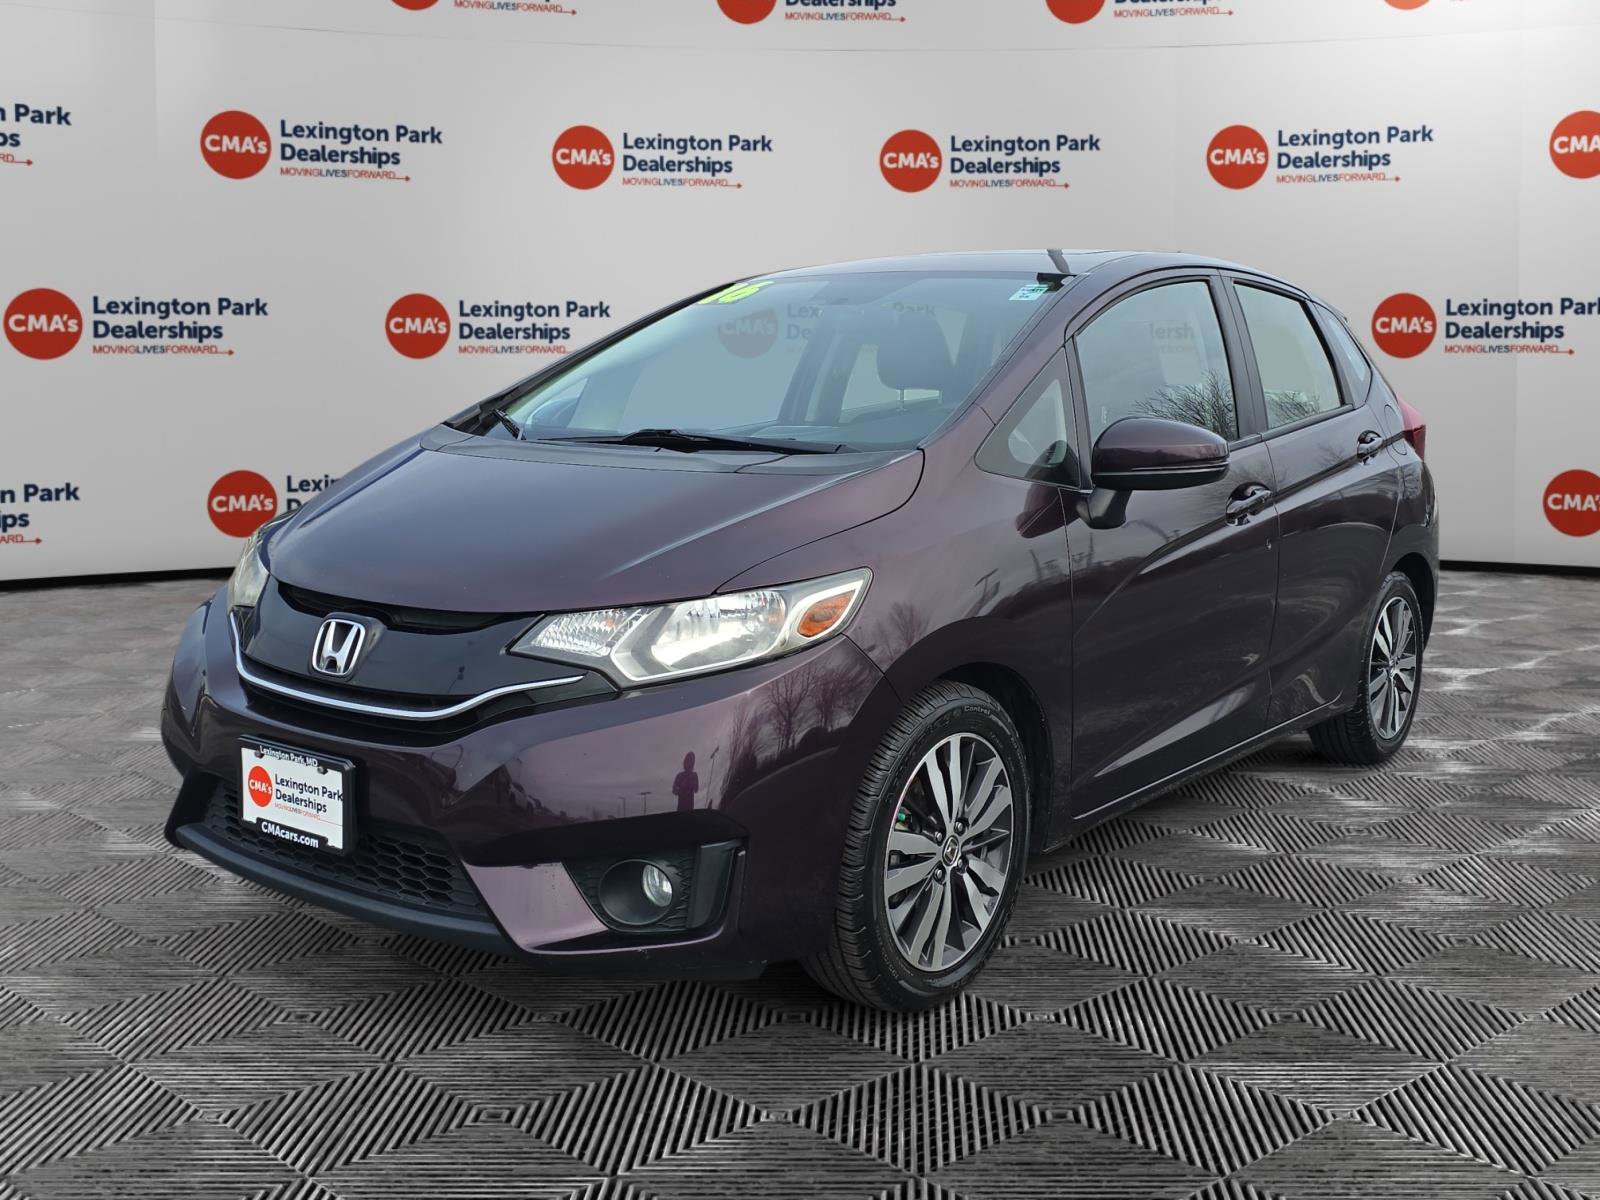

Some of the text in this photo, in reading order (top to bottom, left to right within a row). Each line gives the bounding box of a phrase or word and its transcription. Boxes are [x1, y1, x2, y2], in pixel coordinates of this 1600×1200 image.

[15, 103, 72, 126] Park
[280, 119, 443, 144] Lexington Park
[1277, 125, 1434, 150] Lexington Park
[205, 134, 268, 154] CMA's
[280, 142, 401, 166] Dealerships
[623, 132, 773, 154] Lexington Park
[950, 134, 1100, 156] Lexington Park
[555, 148, 612, 166] CMA's
[622, 154, 733, 176] Dealerships
[882, 151, 940, 169] CMA's
[950, 157, 1061, 178] Dealerships
[1209, 147, 1266, 166] CMA's
[1277, 150, 1391, 171] Dealerships
[92, 295, 268, 317] Lexington Park
[459, 299, 611, 322] Lexington Park
[1445, 298, 1553, 320] Lexington
[10, 313, 79, 333] CMA's
[92, 320, 223, 343] Dealerships
[389, 316, 447, 334] CMA's
[458, 322, 571, 344] Dealerships
[1375, 316, 1434, 334] CMA's
[1445, 320, 1564, 343] Dealerships
[24, 482, 80, 503] Park
[211, 494, 274, 513] CMA's
[260, 745, 290, 761] Lexington
[249, 779, 272, 794] CMA's
[275, 773, 344, 802] Lexington Park
[275, 789, 327, 814] Dealerships
[261, 821, 319, 848] CMAcars.com
